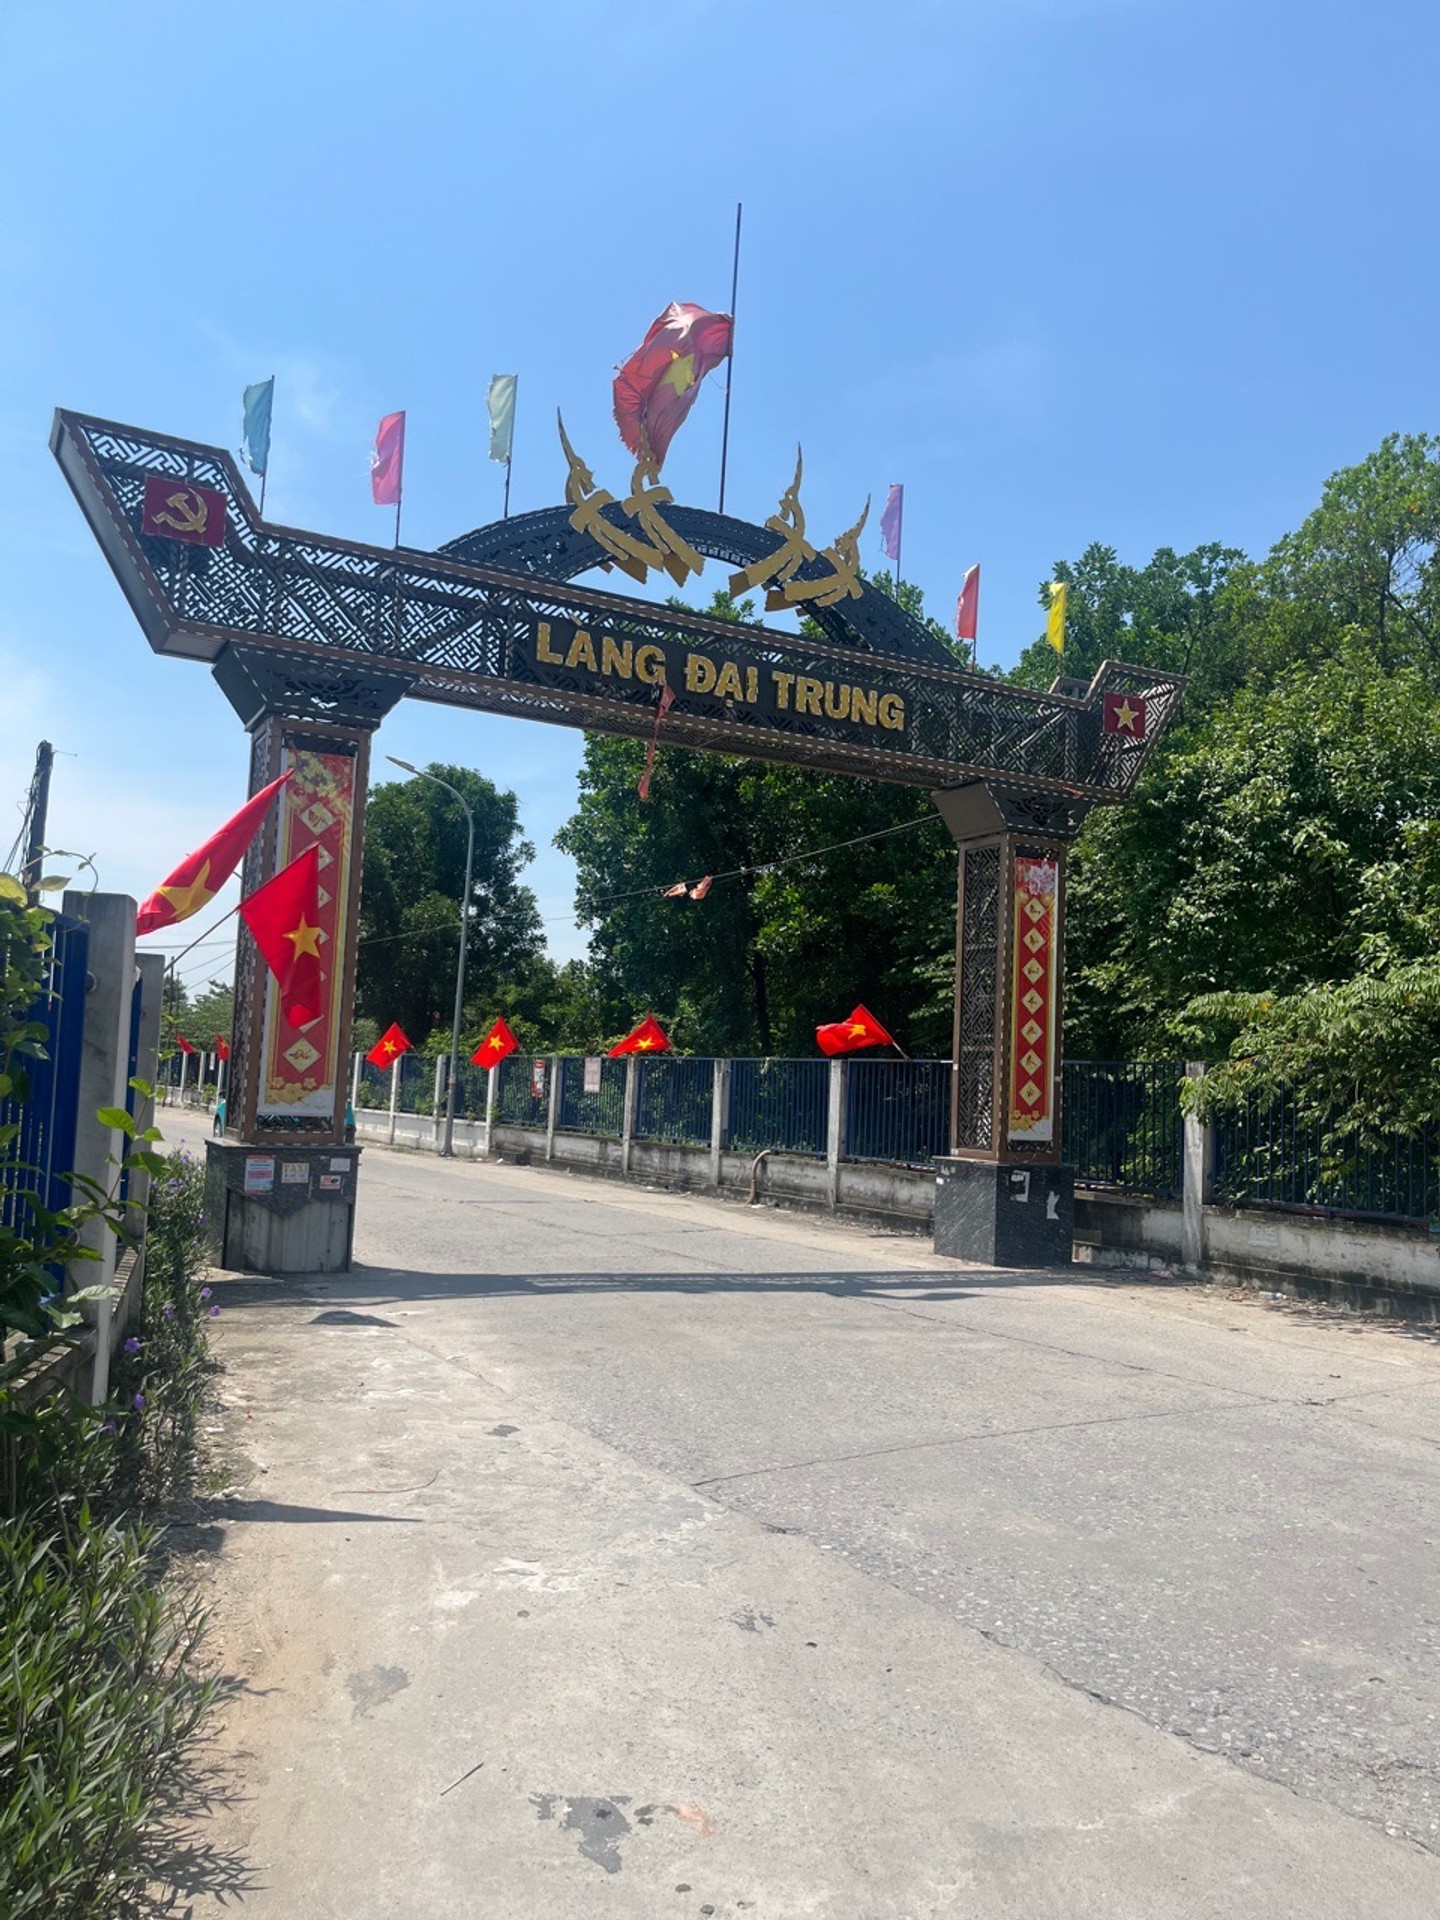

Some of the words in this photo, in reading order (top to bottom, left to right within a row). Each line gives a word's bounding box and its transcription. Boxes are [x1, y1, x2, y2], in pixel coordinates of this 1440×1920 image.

[537, 615, 666, 686] LÀNG
[684, 653, 758, 708] ĐẠI
[772, 671, 905, 731] TRUNG
